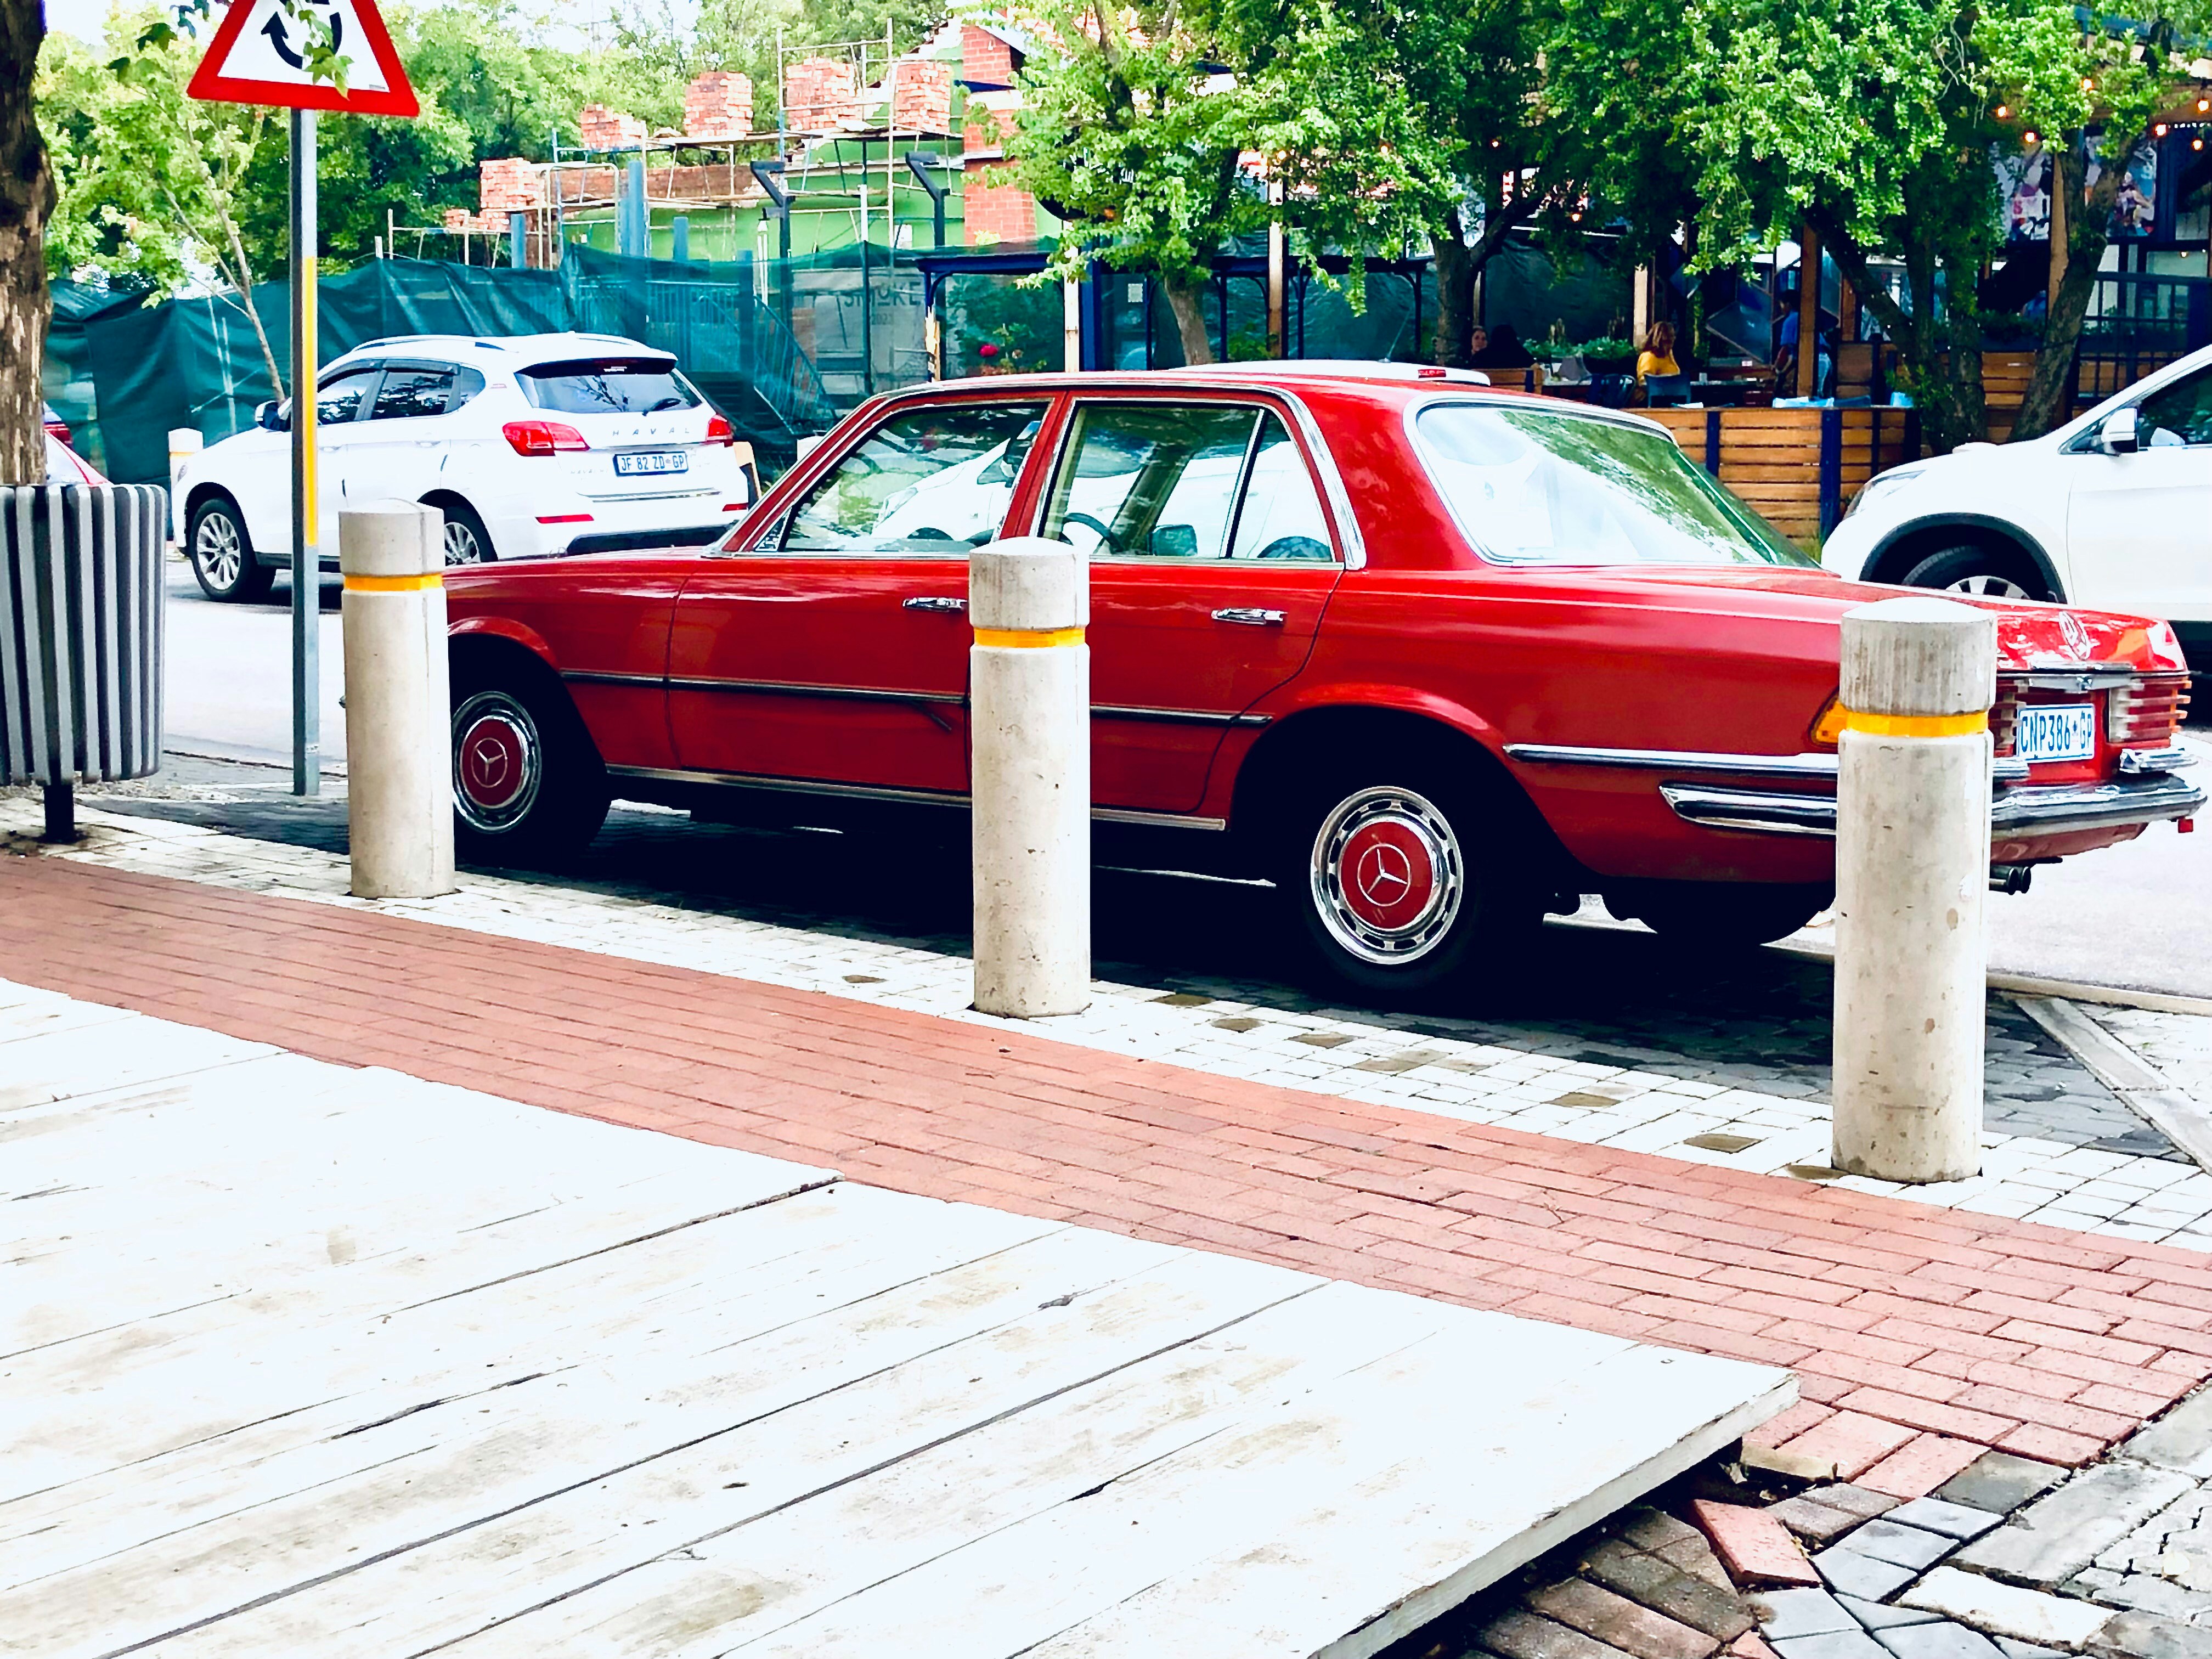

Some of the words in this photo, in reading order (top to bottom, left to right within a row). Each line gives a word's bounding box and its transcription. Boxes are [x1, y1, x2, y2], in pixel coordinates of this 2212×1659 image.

[612, 427, 690, 436] HAVAL
[622, 458, 632, 471] JF
[636, 457, 648, 470] 82
[652, 456, 665, 469] ZD
[672, 455, 684, 468] GP
[2021, 714, 2070, 752] CNP386
[2080, 711, 2092, 749] GP
